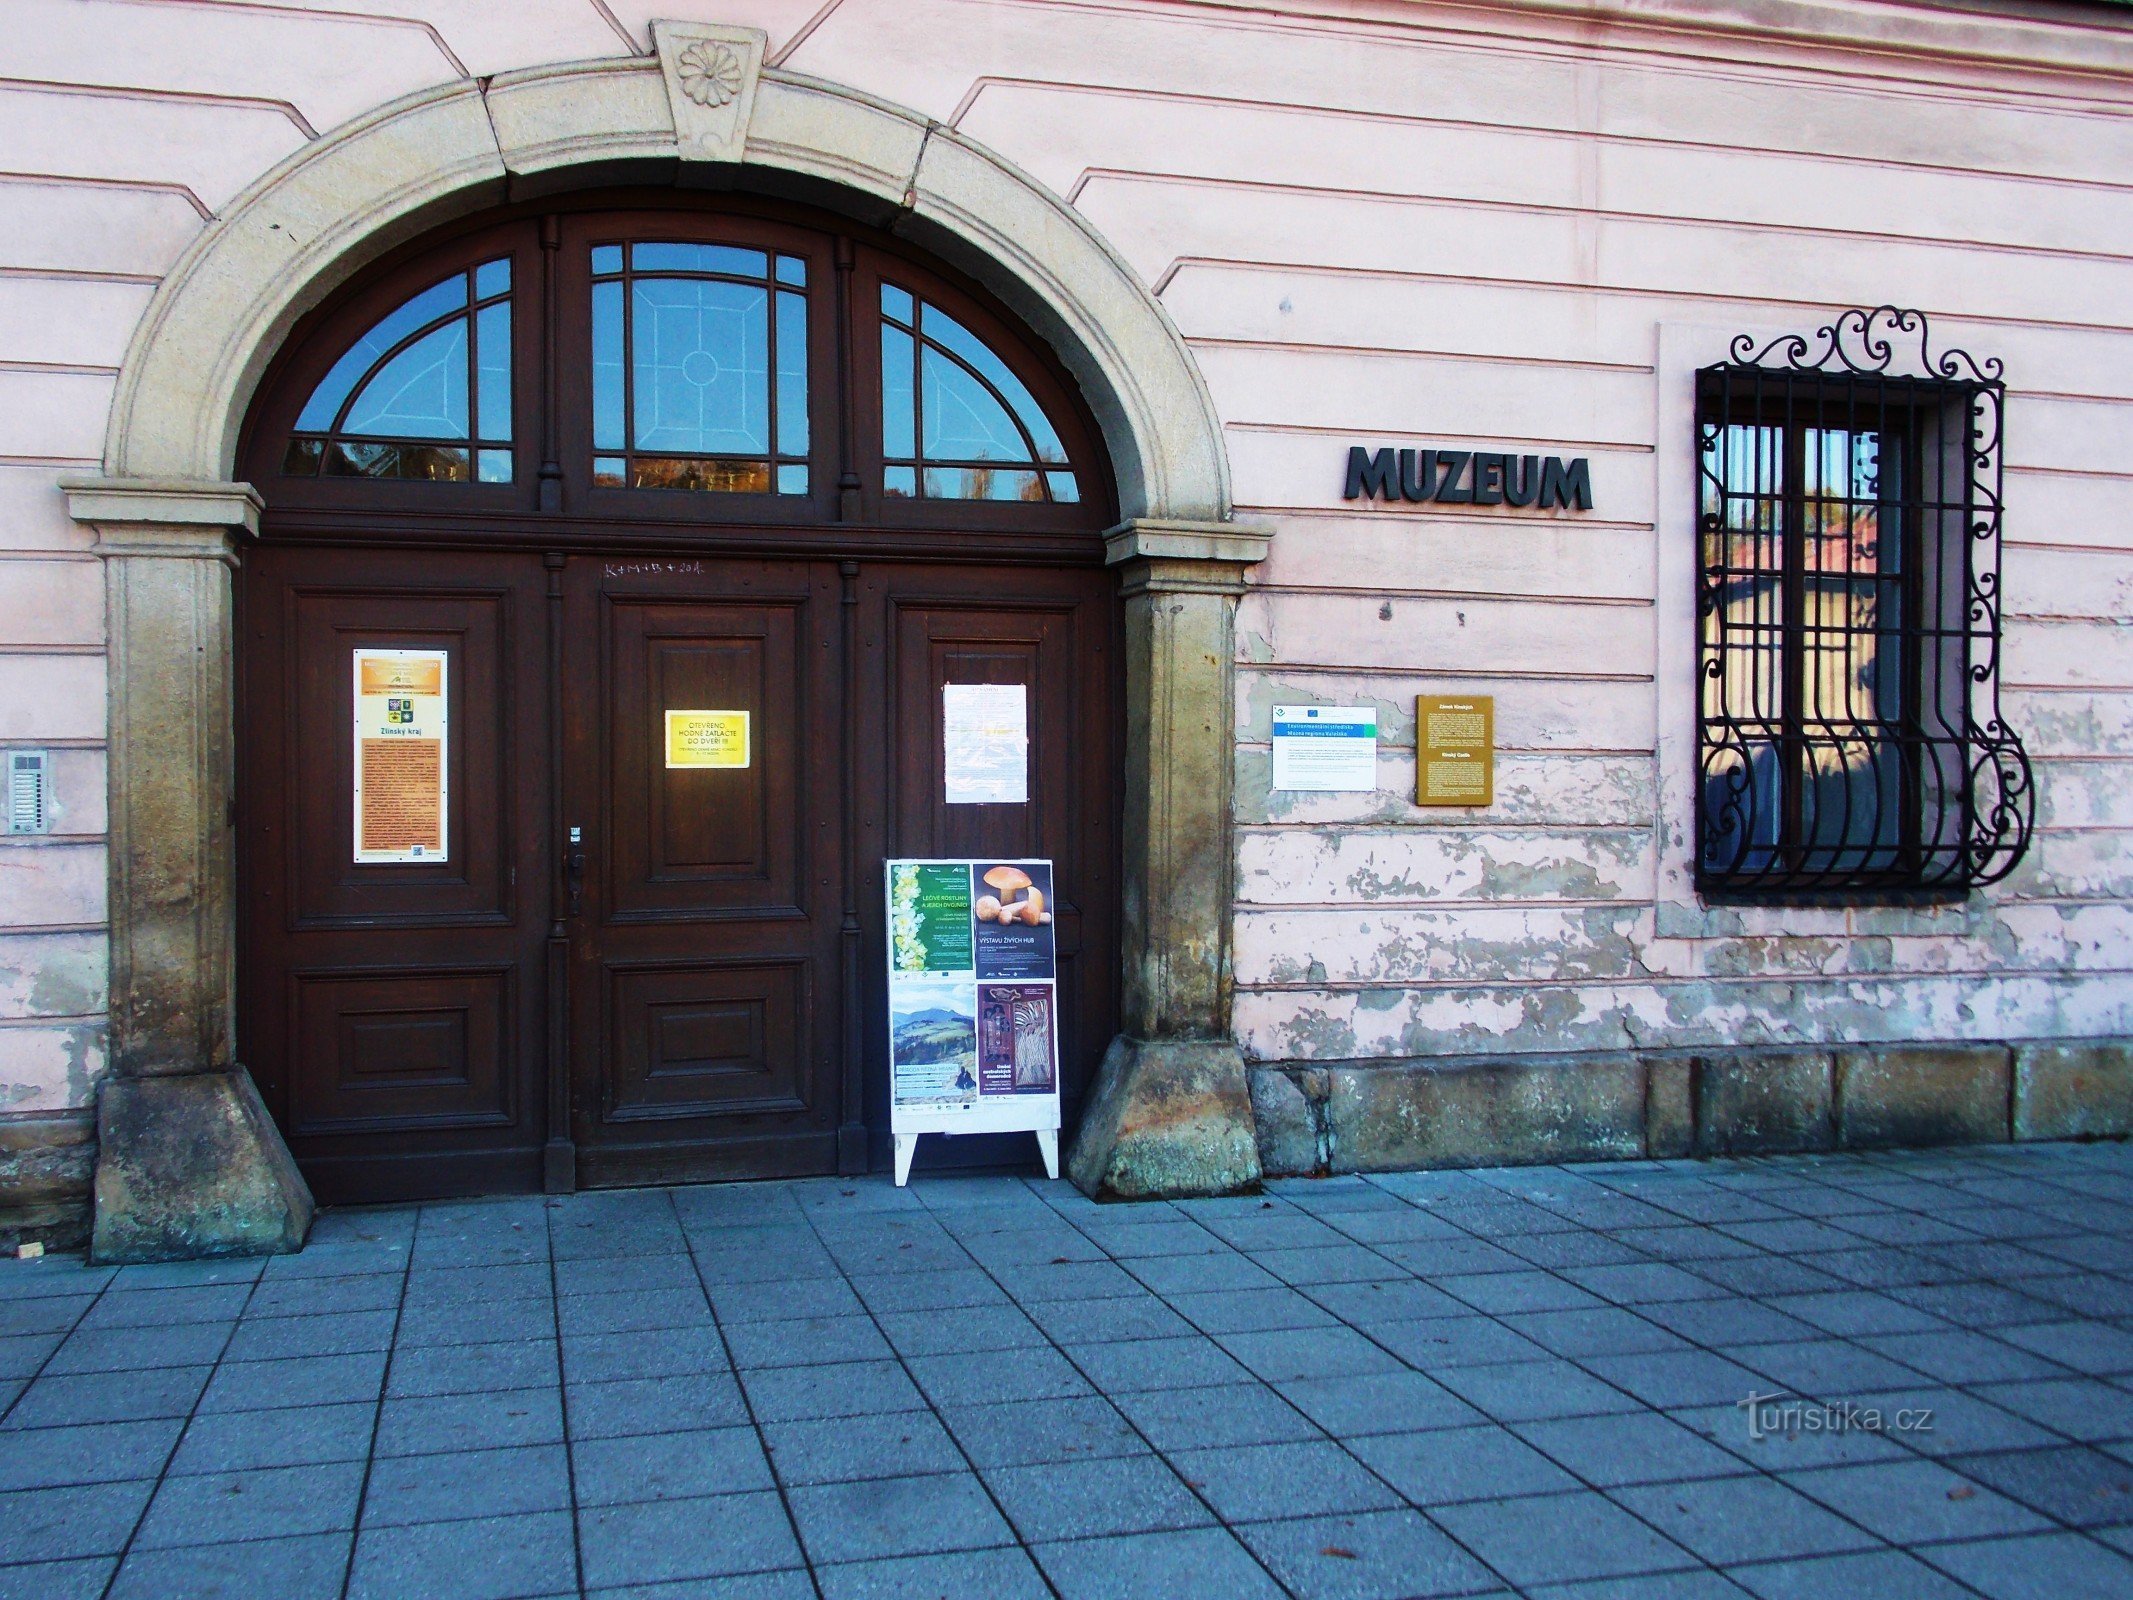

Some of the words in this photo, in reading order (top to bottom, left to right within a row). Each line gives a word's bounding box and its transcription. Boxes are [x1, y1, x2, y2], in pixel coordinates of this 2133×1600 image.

[1343, 446, 1594, 510] MUZEUM
[380, 727, 405, 736] Zlínský
[408, 728, 422, 736] kraj
[1003, 936, 1022, 944] ŽIVÝCH
